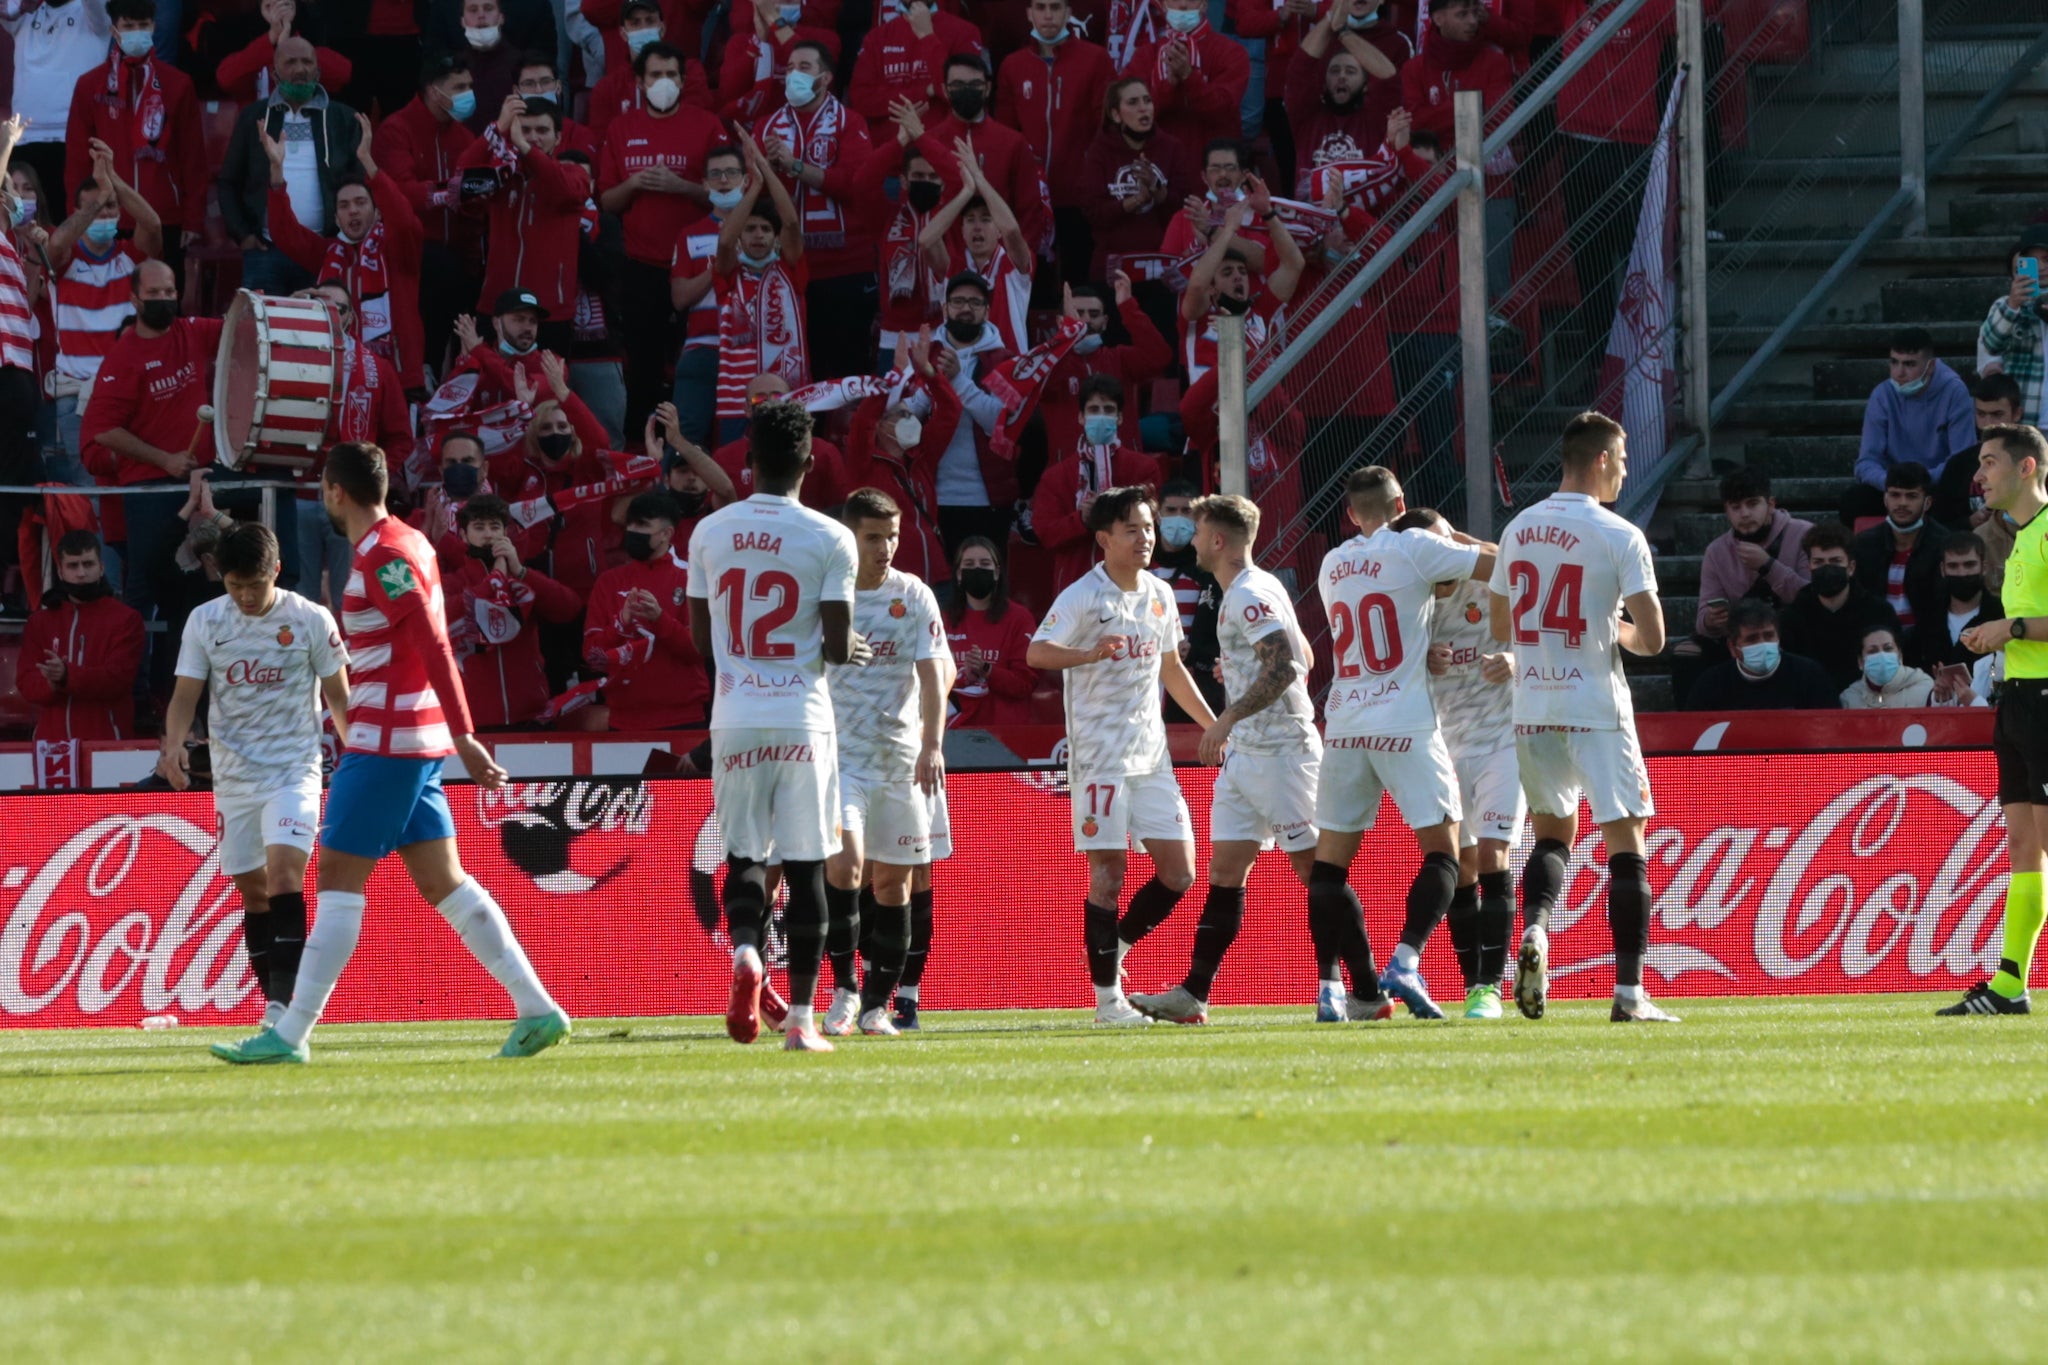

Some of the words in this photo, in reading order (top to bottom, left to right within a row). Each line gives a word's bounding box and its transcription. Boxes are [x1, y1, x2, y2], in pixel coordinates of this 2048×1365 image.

[733, 531, 783, 556] BABA
[1516, 525, 1581, 553] VALJENT
[1329, 559, 1382, 587] SEDLAR
[715, 567, 800, 660] 12
[1508, 560, 1587, 650] 24
[1330, 592, 1404, 681] 20
[739, 673, 807, 688] ALUA
[1523, 665, 1584, 681] ALUA
[1086, 783, 1116, 817] 17
